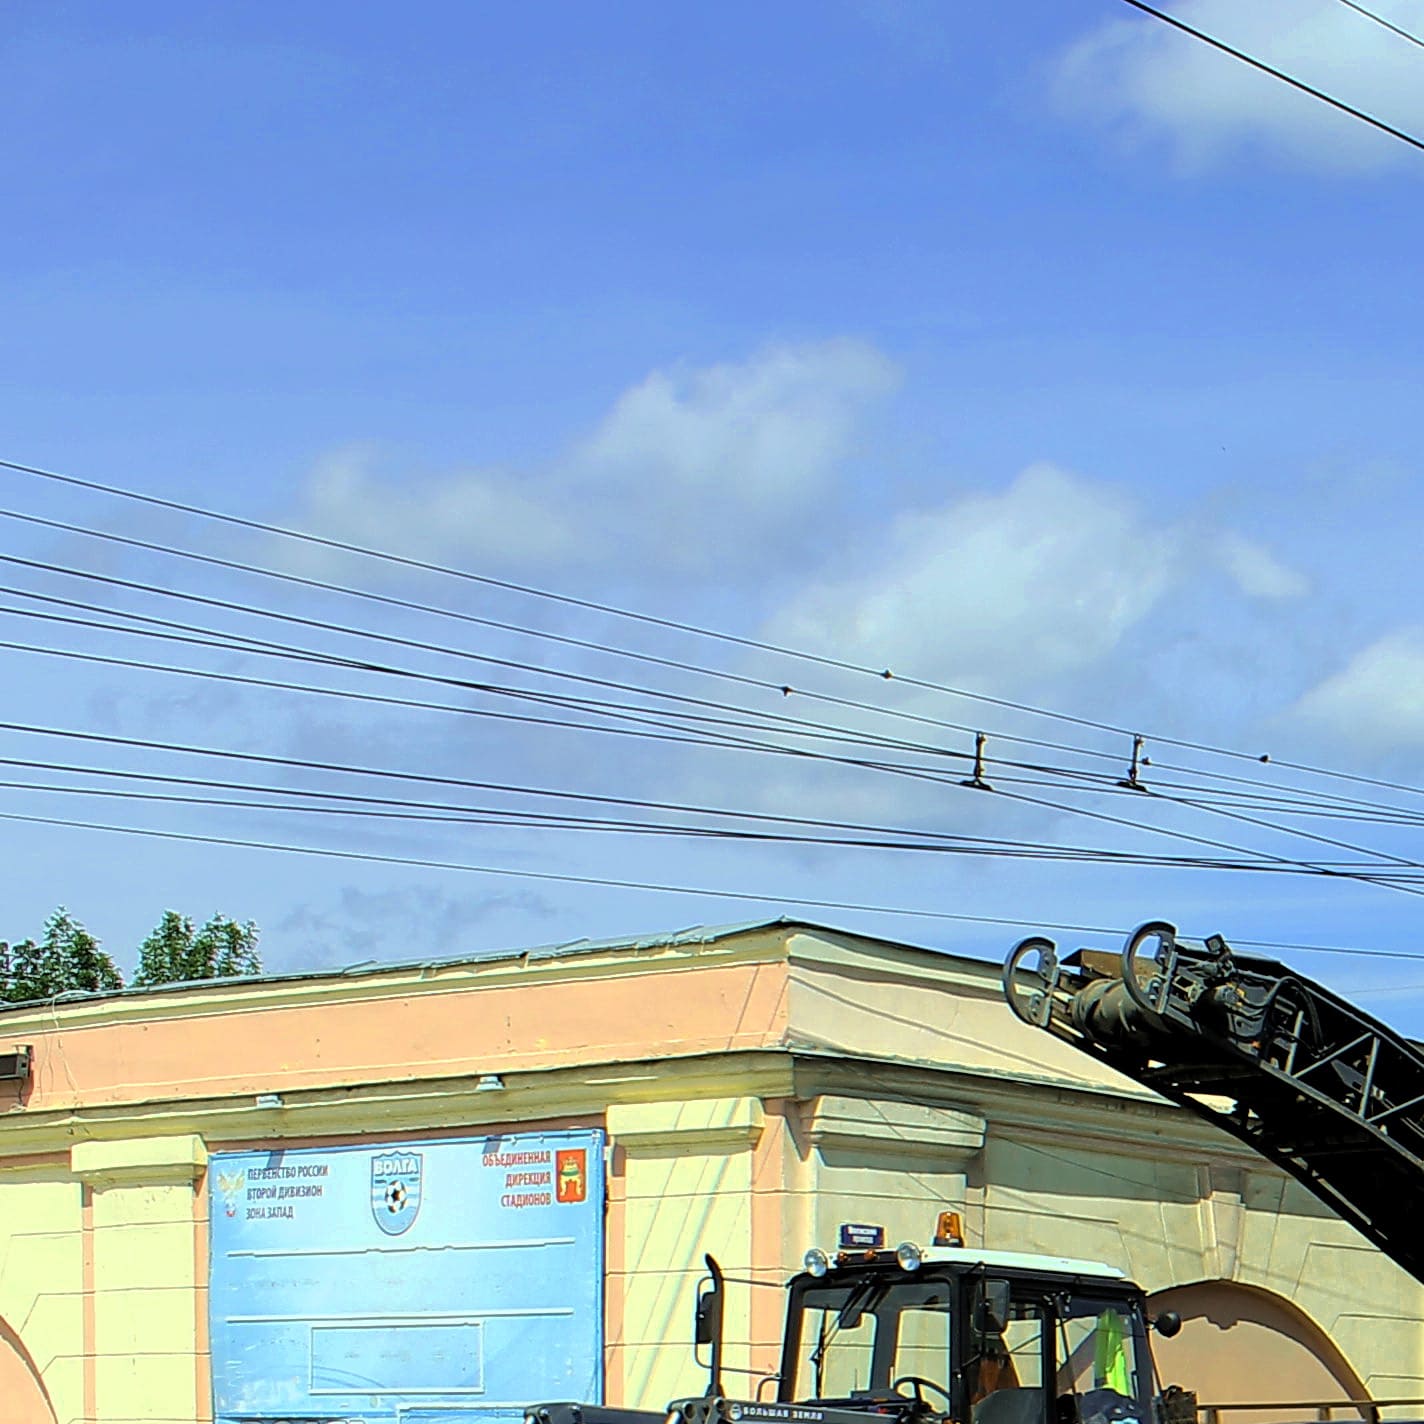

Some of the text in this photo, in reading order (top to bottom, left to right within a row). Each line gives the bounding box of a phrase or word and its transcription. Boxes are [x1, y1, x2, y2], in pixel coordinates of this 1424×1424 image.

[374, 1158, 419, 1176] ВОЛГА
[482, 1151, 552, 1168] ОБЪЕДИНЕННАЯ
[247, 1165, 329, 1180] ПЕРВЕНСТВО РОССИИ
[505, 1171, 552, 1188] ДИРЕКЦИЯ
[247, 1185, 323, 1200] ВТОРОЙ ДИВИЗИОН
[500, 1192, 552, 1208] СТАДИОНОВ
[246, 1205, 294, 1220] ЗОНА ЗАПАД
[743, 1406, 824, 1421] БОЛЬШАЯ ЗЕМЛЯ
